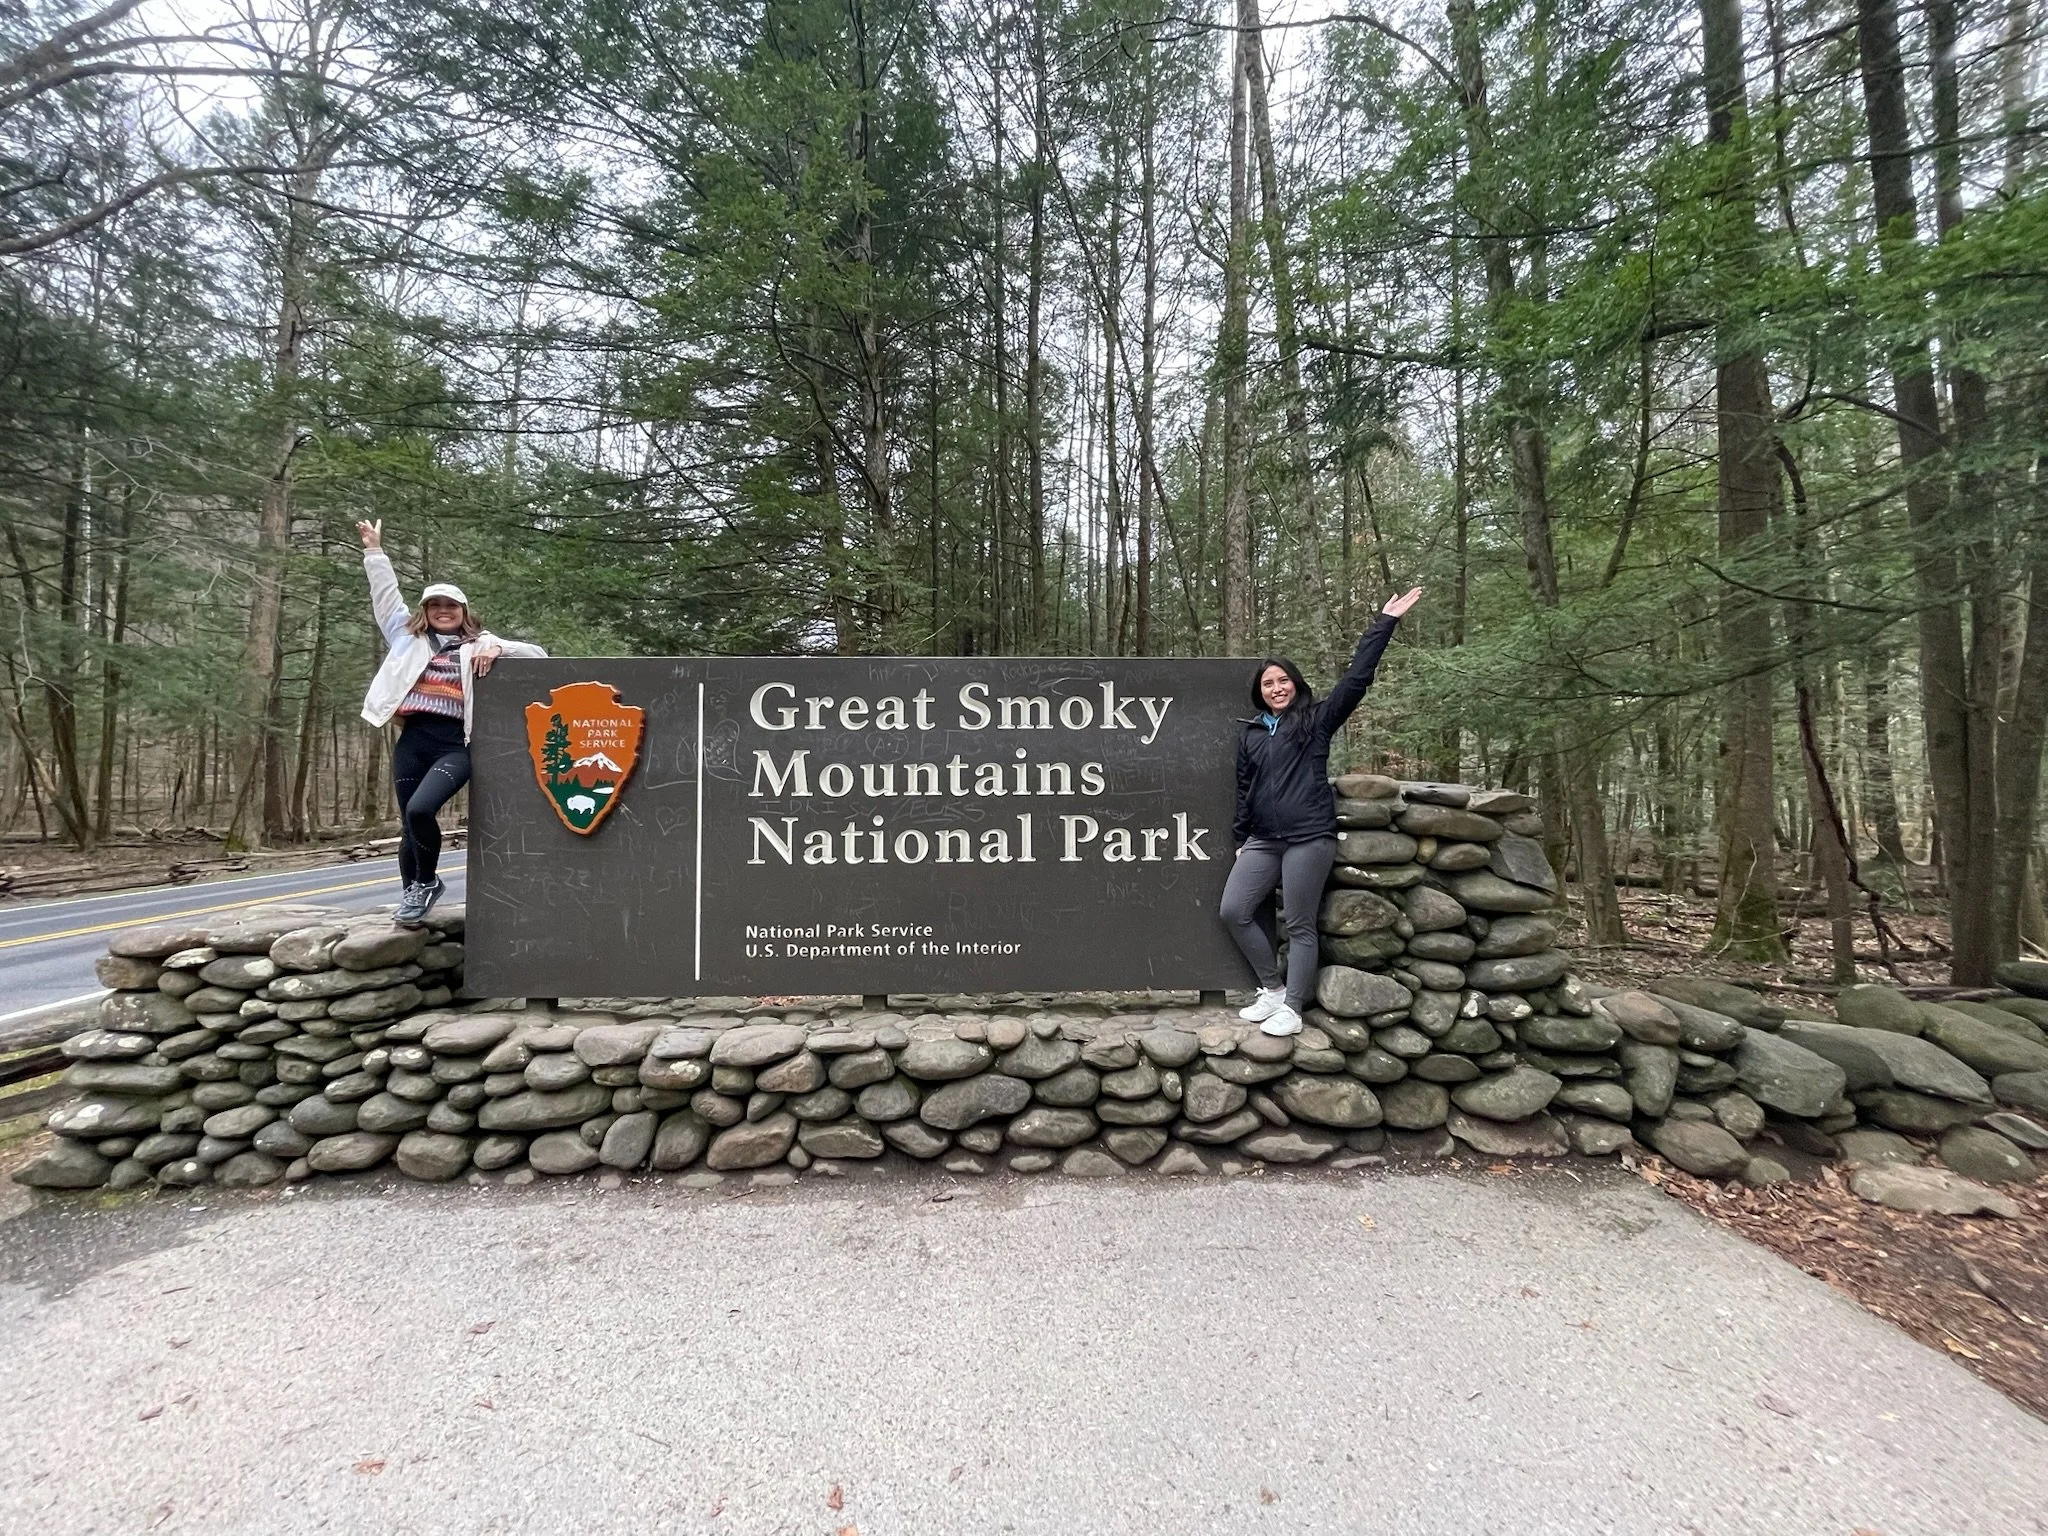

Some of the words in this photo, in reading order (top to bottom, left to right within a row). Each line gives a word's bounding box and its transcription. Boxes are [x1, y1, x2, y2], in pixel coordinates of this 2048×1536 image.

[749, 682, 936, 731] Great
[958, 677, 1174, 745] Smoky
[572, 719, 633, 728] NATIONAL
[587, 729, 618, 738] PARK
[579, 739, 626, 748] SERVICE
[747, 747, 1106, 798] Mountains
[746, 812, 1037, 865] National
[1059, 811, 1211, 863] Park
[745, 923, 821, 939] National
[826, 923, 865, 938] Park
[871, 922, 933, 938] Service
[745, 943, 779, 958] U.S.
[786, 943, 891, 961] Department
[896, 940, 916, 956] of
[921, 940, 950, 956] the
[956, 940, 1021, 955] Interior
